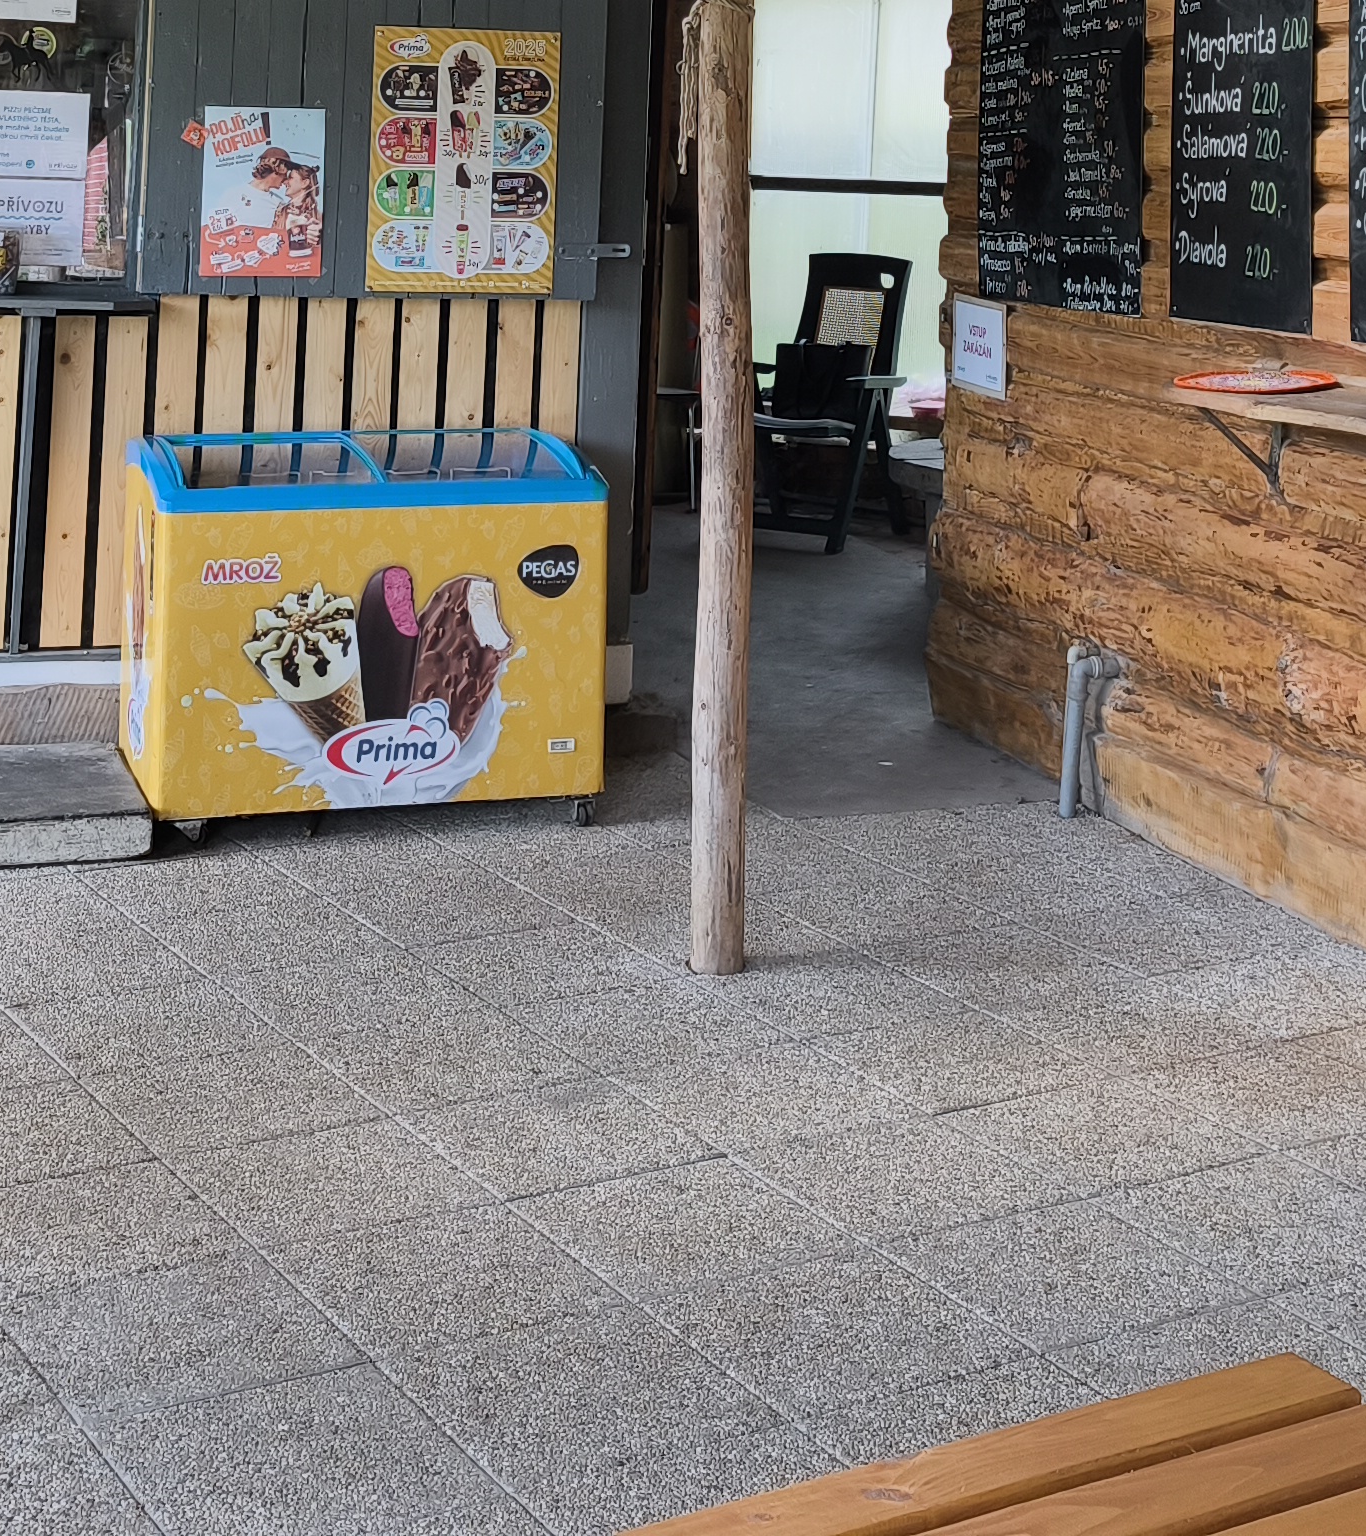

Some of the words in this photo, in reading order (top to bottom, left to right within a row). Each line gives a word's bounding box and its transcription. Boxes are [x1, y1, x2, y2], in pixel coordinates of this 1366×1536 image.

[398, 43, 424, 52] Prima
[504, 39, 547, 56] 2025
[1187, 14, 1276, 71] Margherita
[1185, 71, 1245, 115] Šunková
[1183, 123, 1250, 159] Salámová
[1180, 168, 1230, 218] Sýrová
[1179, 226, 1226, 267] Diavola
[969, 324, 986, 339] VSTUP
[963, 340, 991, 359] ZAKÁZÁN
[202, 553, 282, 584] MROŽ
[522, 560, 575, 578] PEGAS
[356, 737, 438, 764] Prima
